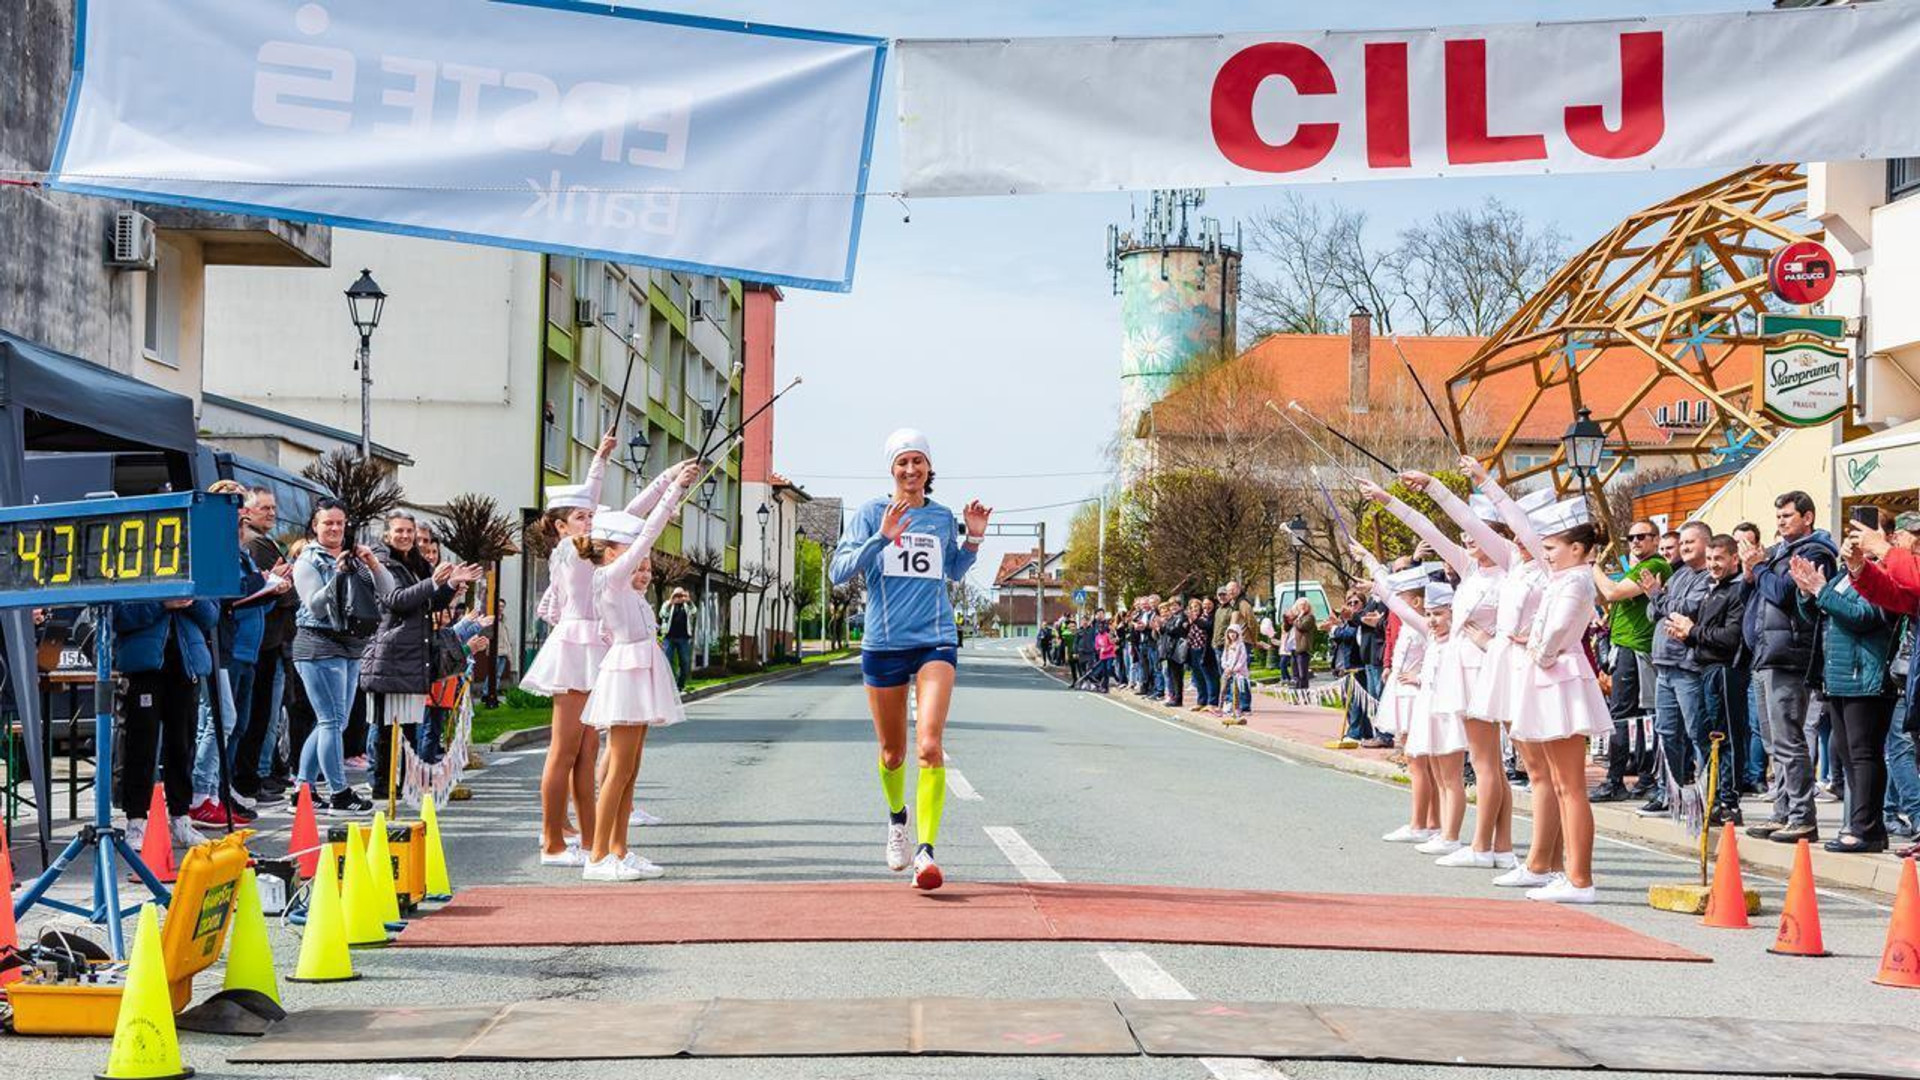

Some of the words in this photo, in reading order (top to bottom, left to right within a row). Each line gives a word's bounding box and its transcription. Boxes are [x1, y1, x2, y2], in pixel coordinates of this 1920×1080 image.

[1210, 31, 1666, 173] CILJ
[1784, 272, 1826, 281] PASCUCCI
[1769, 358, 1841, 389] Staropramen
[897, 550, 931, 574] 16
